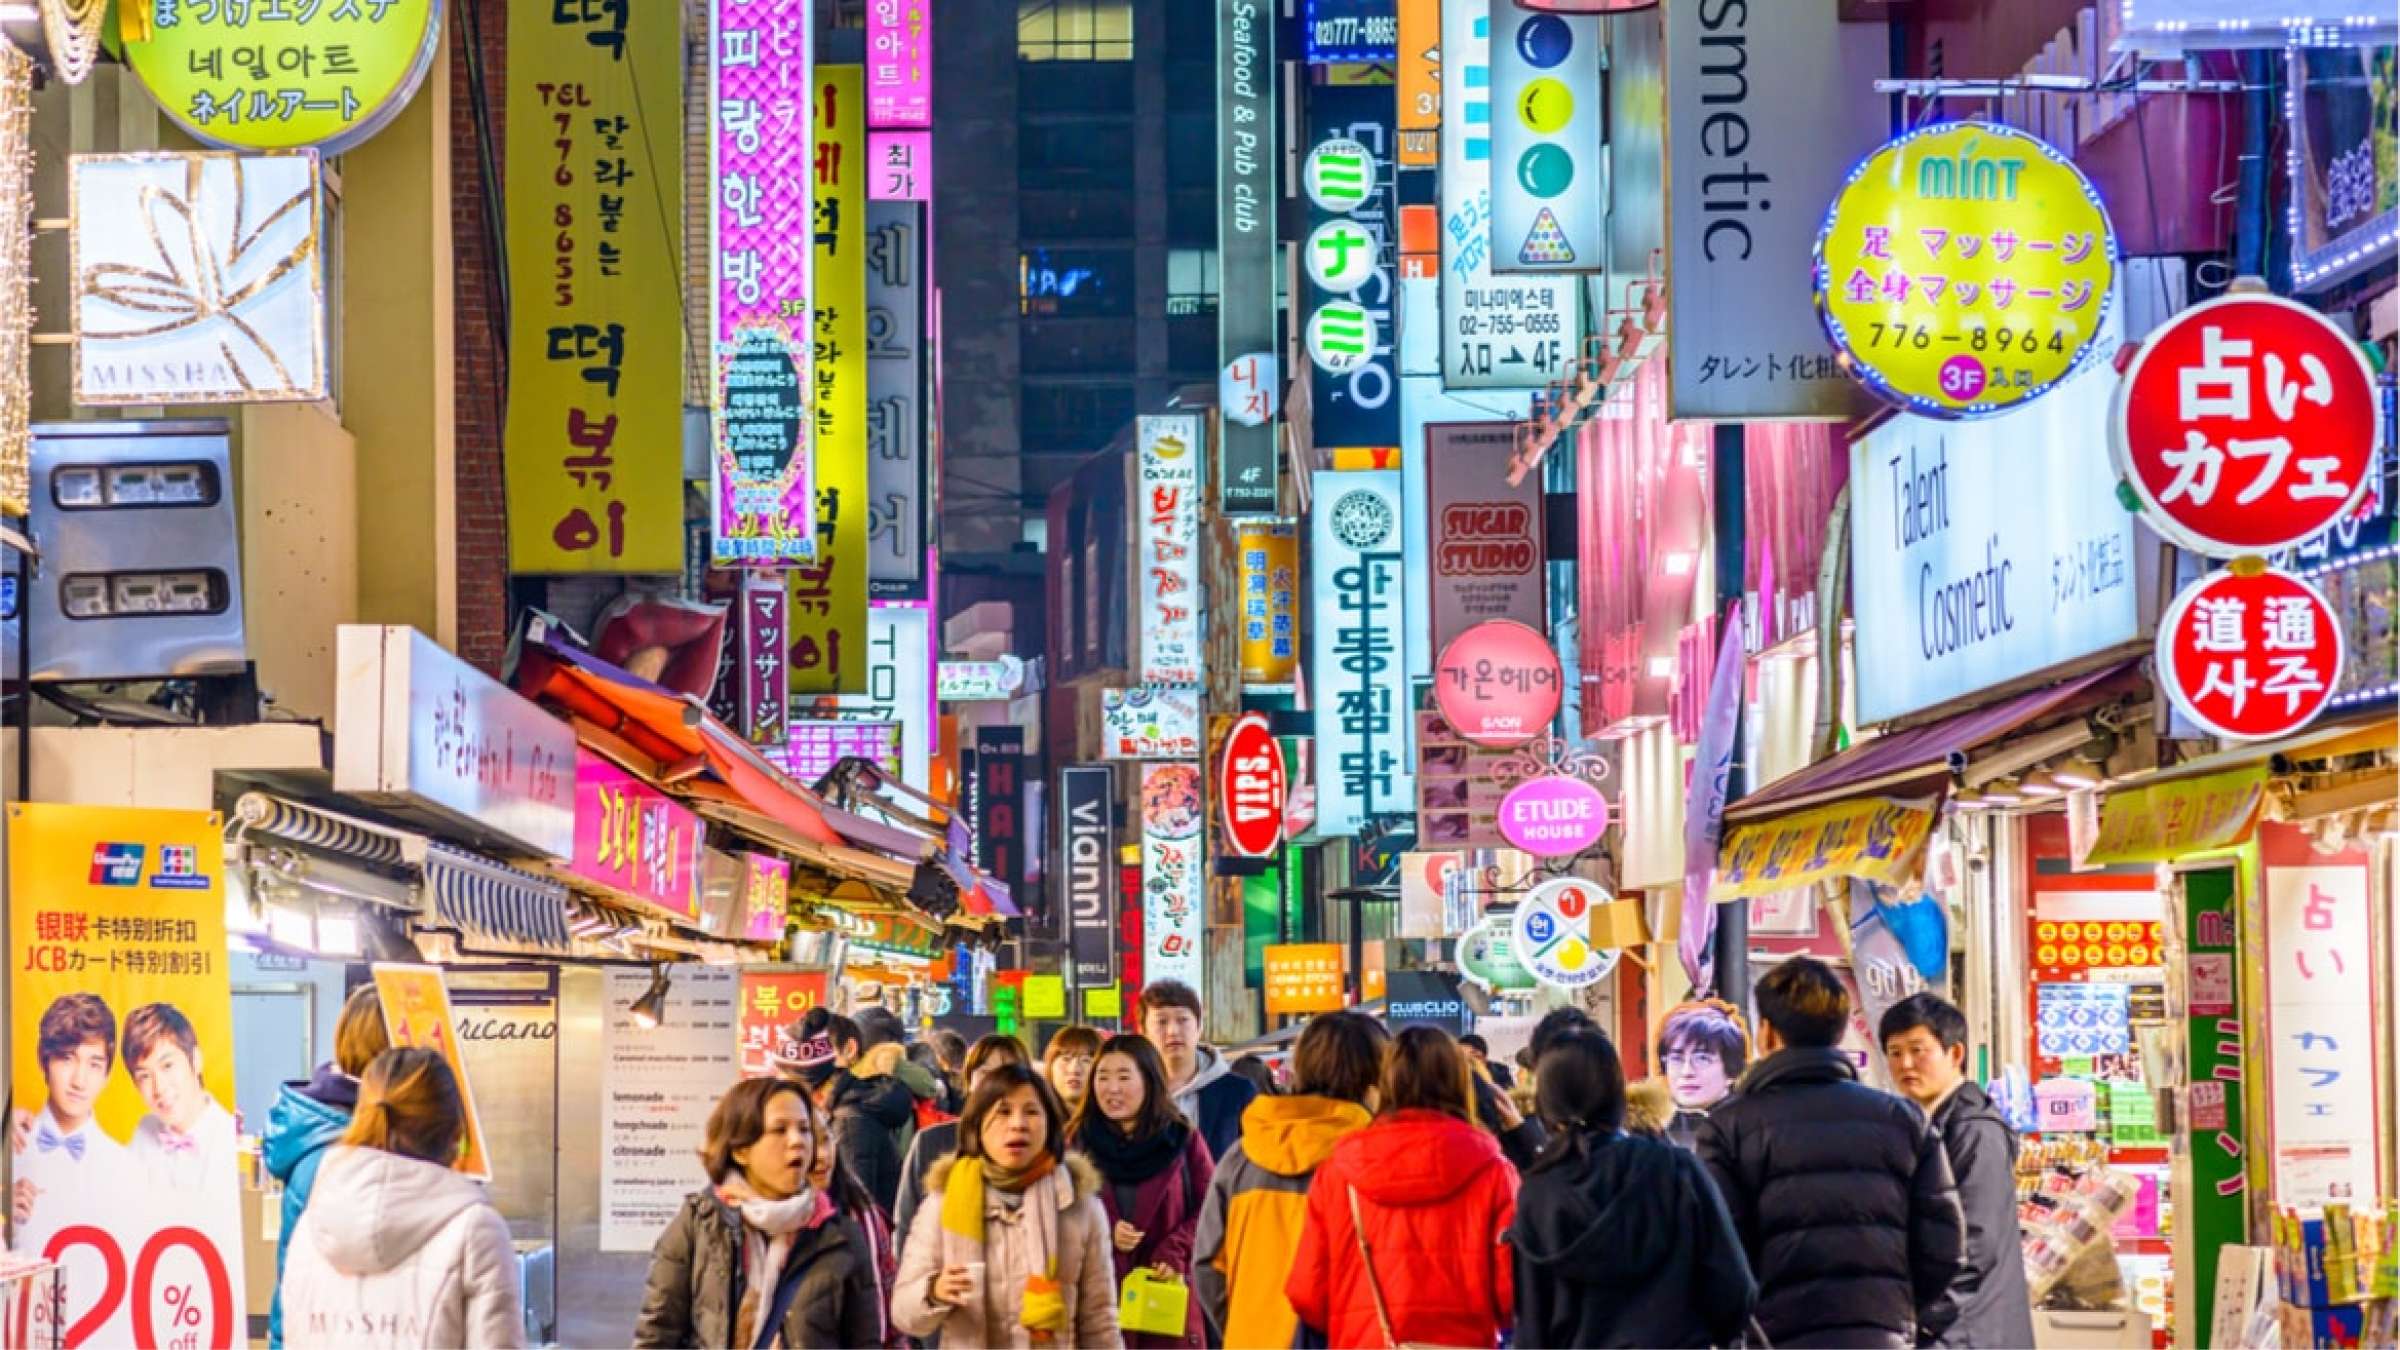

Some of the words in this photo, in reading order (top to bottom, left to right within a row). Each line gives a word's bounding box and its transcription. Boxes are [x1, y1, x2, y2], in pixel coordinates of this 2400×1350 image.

[188, 44, 360, 80] 네일아트
[1234, 0, 1257, 98] Seafood
[188, 88, 361, 124] ネイルアート
[536, 82, 592, 107] TEL
[1235, 106, 1256, 124] &
[1235, 131, 1257, 175] Pub
[1236, 183, 1258, 232] club
[1861, 227, 1890, 258] 足
[1921, 229, 2093, 263] マッサージ
[1464, 289, 1554, 310] 미나미에스테
[1847, 270, 2092, 310] 全身マッサージ
[780, 299, 806, 318] 3F
[1869, 323, 2064, 354] 776-8964
[90, 361, 230, 386] MISSHA
[1460, 342, 1492, 375] 入口
[1533, 343, 1560, 374] 4F
[1699, 355, 1852, 384] タレント化粧
[2178, 326, 2334, 420] 占い
[1943, 365, 1981, 391] 3F
[2159, 431, 2349, 506] カフェ
[1890, 433, 1950, 552] Talent
[1446, 506, 1524, 536] SUGAR
[1441, 545, 1534, 571] STUDIO
[1917, 530, 2015, 662] Cosmetic
[755, 597, 780, 728] マッサージ
[1441, 659, 1557, 701] 가온헤어
[1332, 565, 1397, 798] 안동찜닭
[2193, 657, 2324, 720] 사주
[1514, 799, 1593, 823] ETUDE
[1523, 825, 1584, 841] HOUSE
[1071, 800, 1107, 928] vianni
[2295, 883, 2345, 979] 占い
[2289, 1030, 2341, 1116] カフェ
[612, 1091, 664, 1102] lemonade
[41, 1224, 234, 1350] 20
[163, 1284, 202, 1328] %
